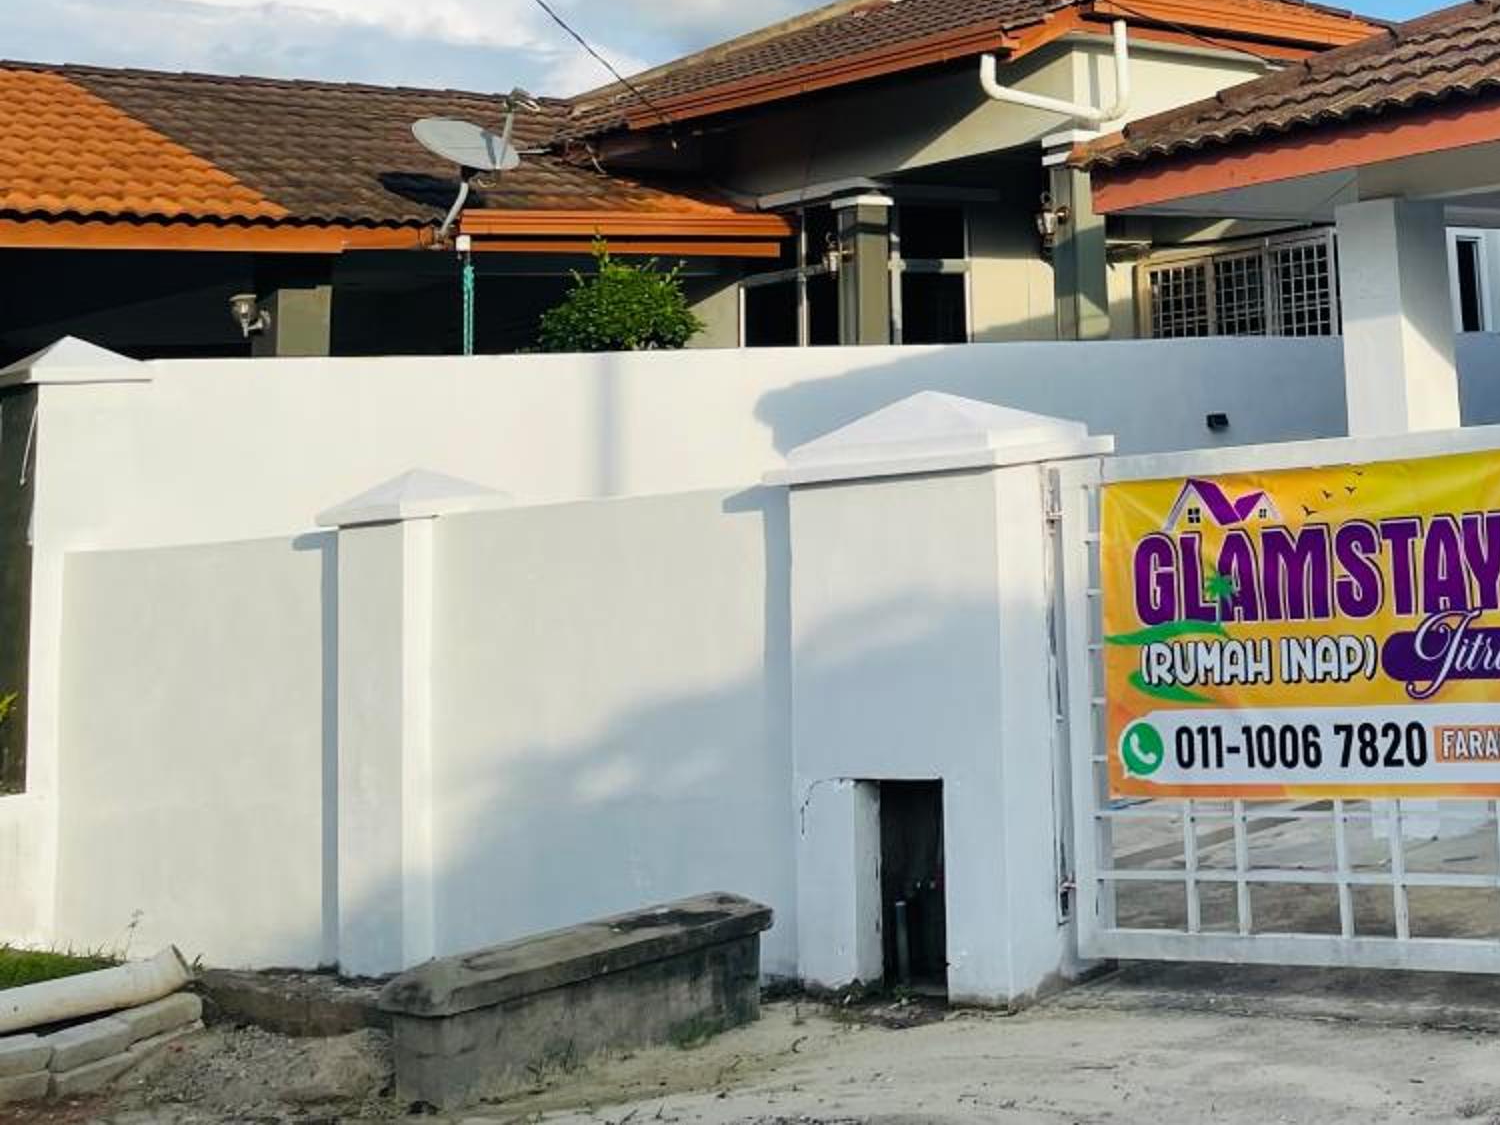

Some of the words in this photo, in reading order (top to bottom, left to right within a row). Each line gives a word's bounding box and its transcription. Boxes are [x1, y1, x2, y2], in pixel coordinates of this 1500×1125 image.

[1141, 637, 1272, 686] (RUMAH
[1279, 634, 1377, 683] INAP)
[1175, 725, 1322, 769] 011-1006
[1333, 721, 1427, 768] 7820
